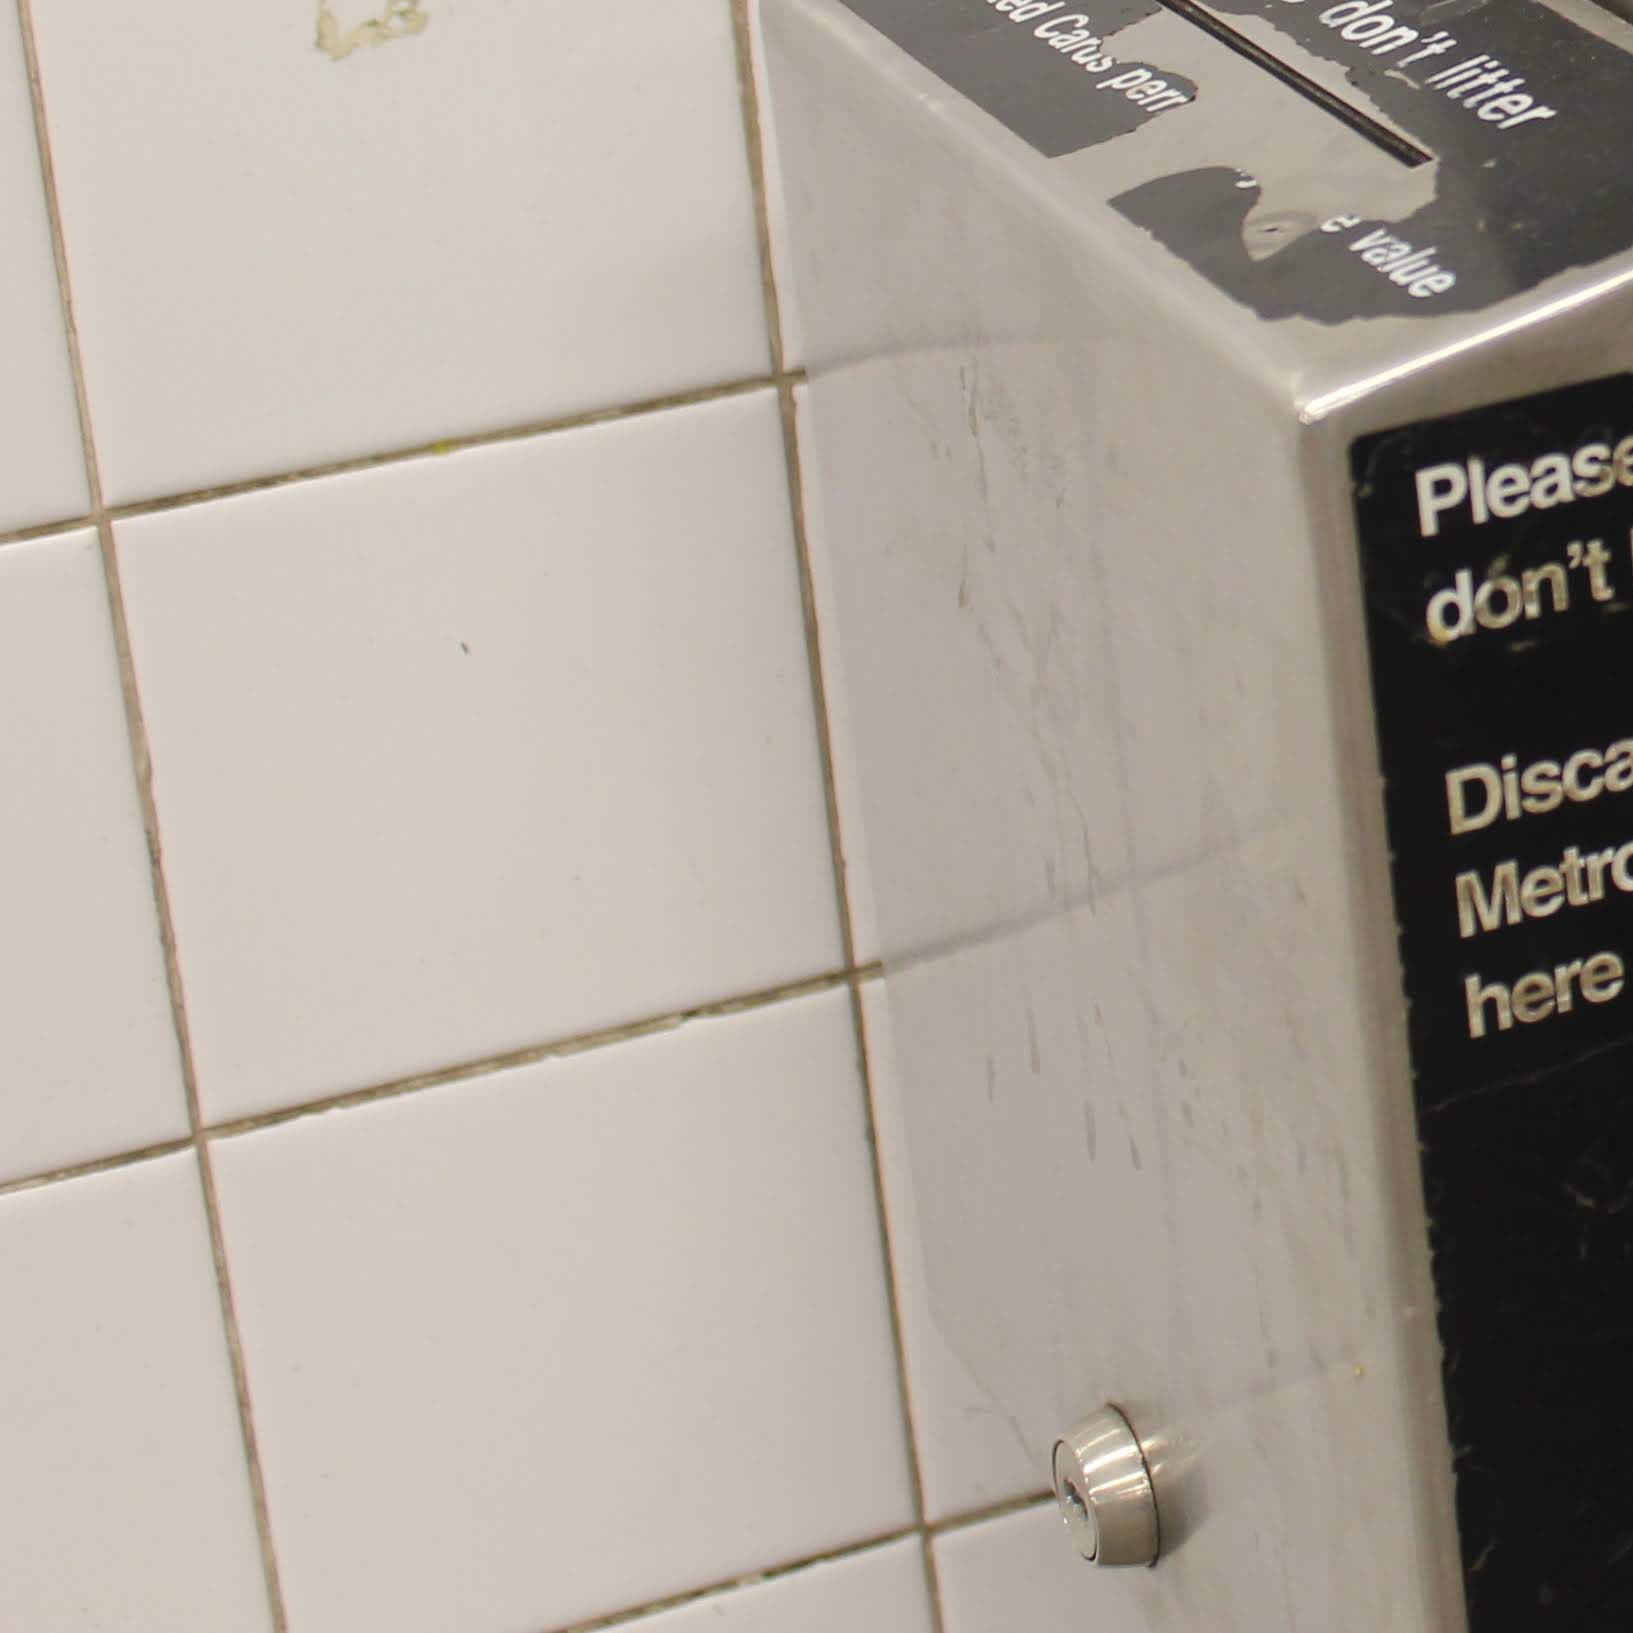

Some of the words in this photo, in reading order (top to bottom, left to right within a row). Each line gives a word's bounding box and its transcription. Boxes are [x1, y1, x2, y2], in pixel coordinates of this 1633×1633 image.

[1425, 54, 1557, 131] litter
[1348, 229, 1457, 298] value
[1425, 540, 1614, 645] don't
[1465, 950, 1625, 1038] here
